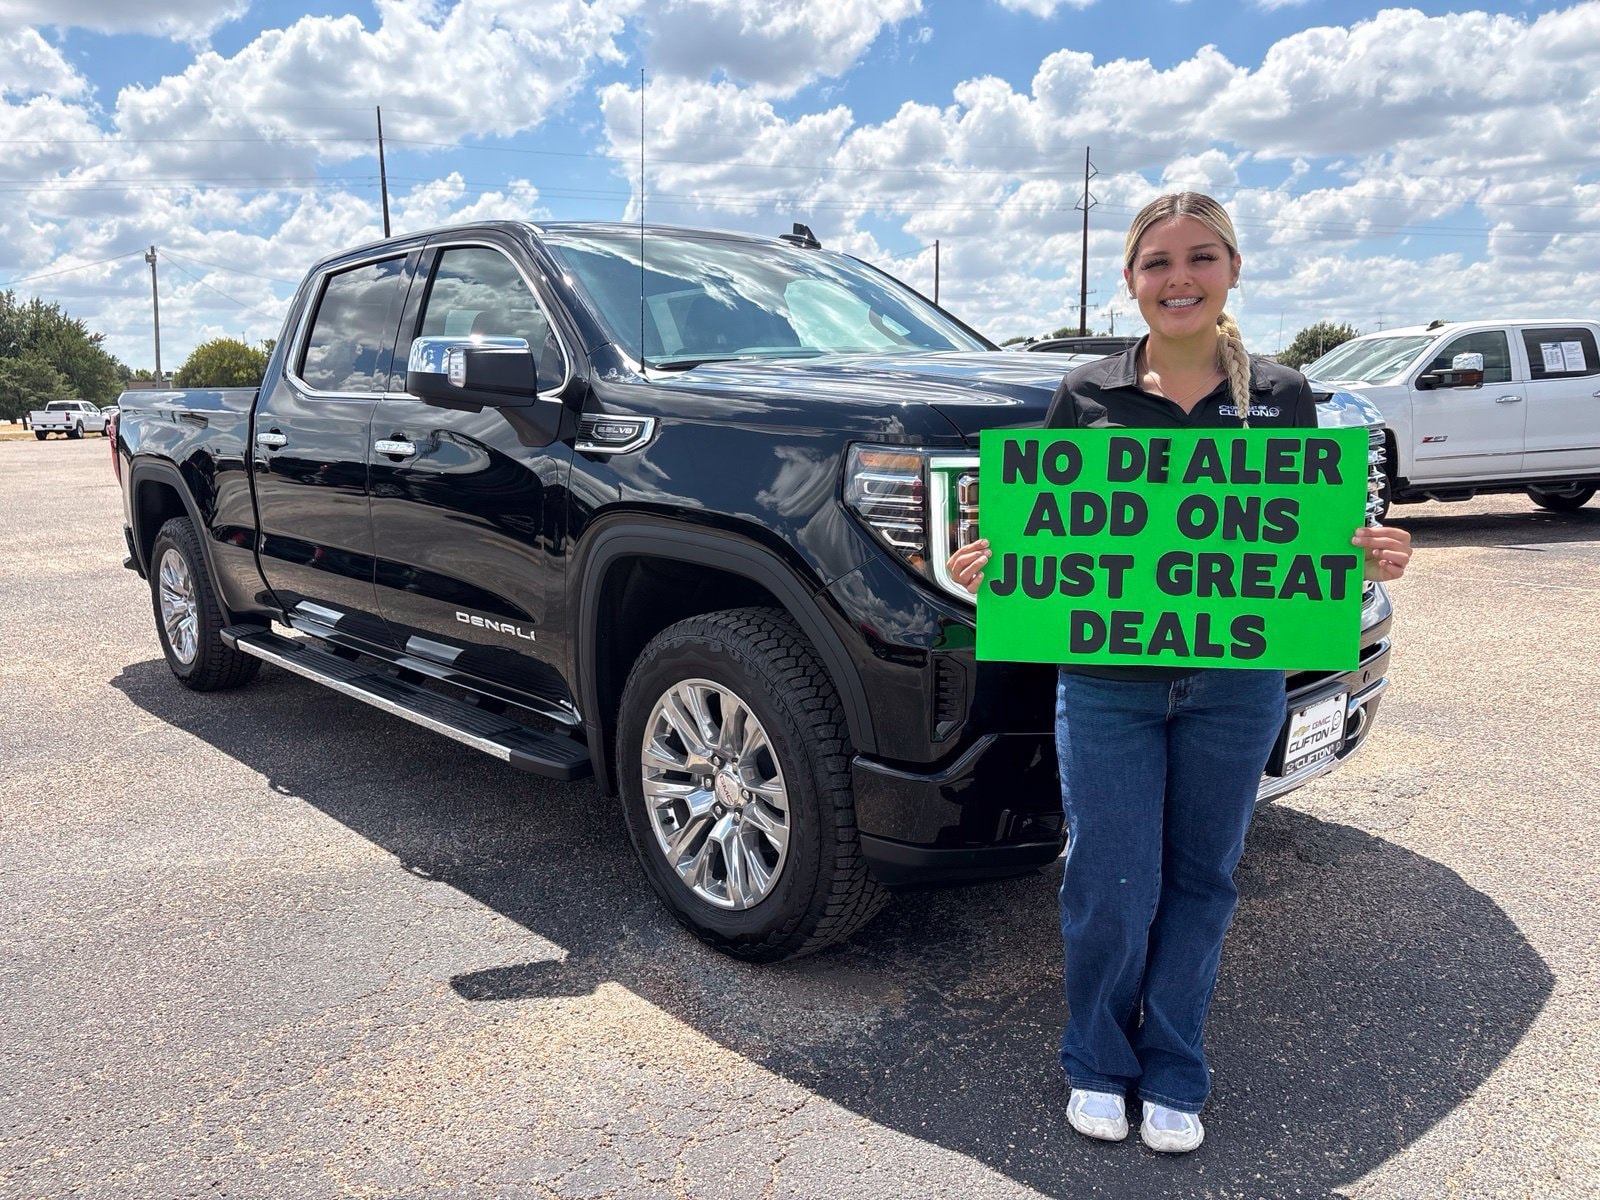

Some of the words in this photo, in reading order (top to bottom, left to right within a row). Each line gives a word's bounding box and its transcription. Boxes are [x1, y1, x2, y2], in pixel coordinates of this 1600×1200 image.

[1219, 409, 1268, 417] CLITON
[1002, 439, 1083, 486] NO
[1023, 491, 1149, 537] ADD
[1176, 494, 1300, 544] ONS
[989, 552, 1135, 600] JUST
[1155, 550, 1358, 601] GREAT
[455, 611, 536, 641] DENALI
[1069, 609, 1267, 660] DEALS
[1312, 715, 1331, 730] GMC
[1289, 727, 1330, 754] CLIFTON
[1296, 745, 1331, 769] CLIFTON
